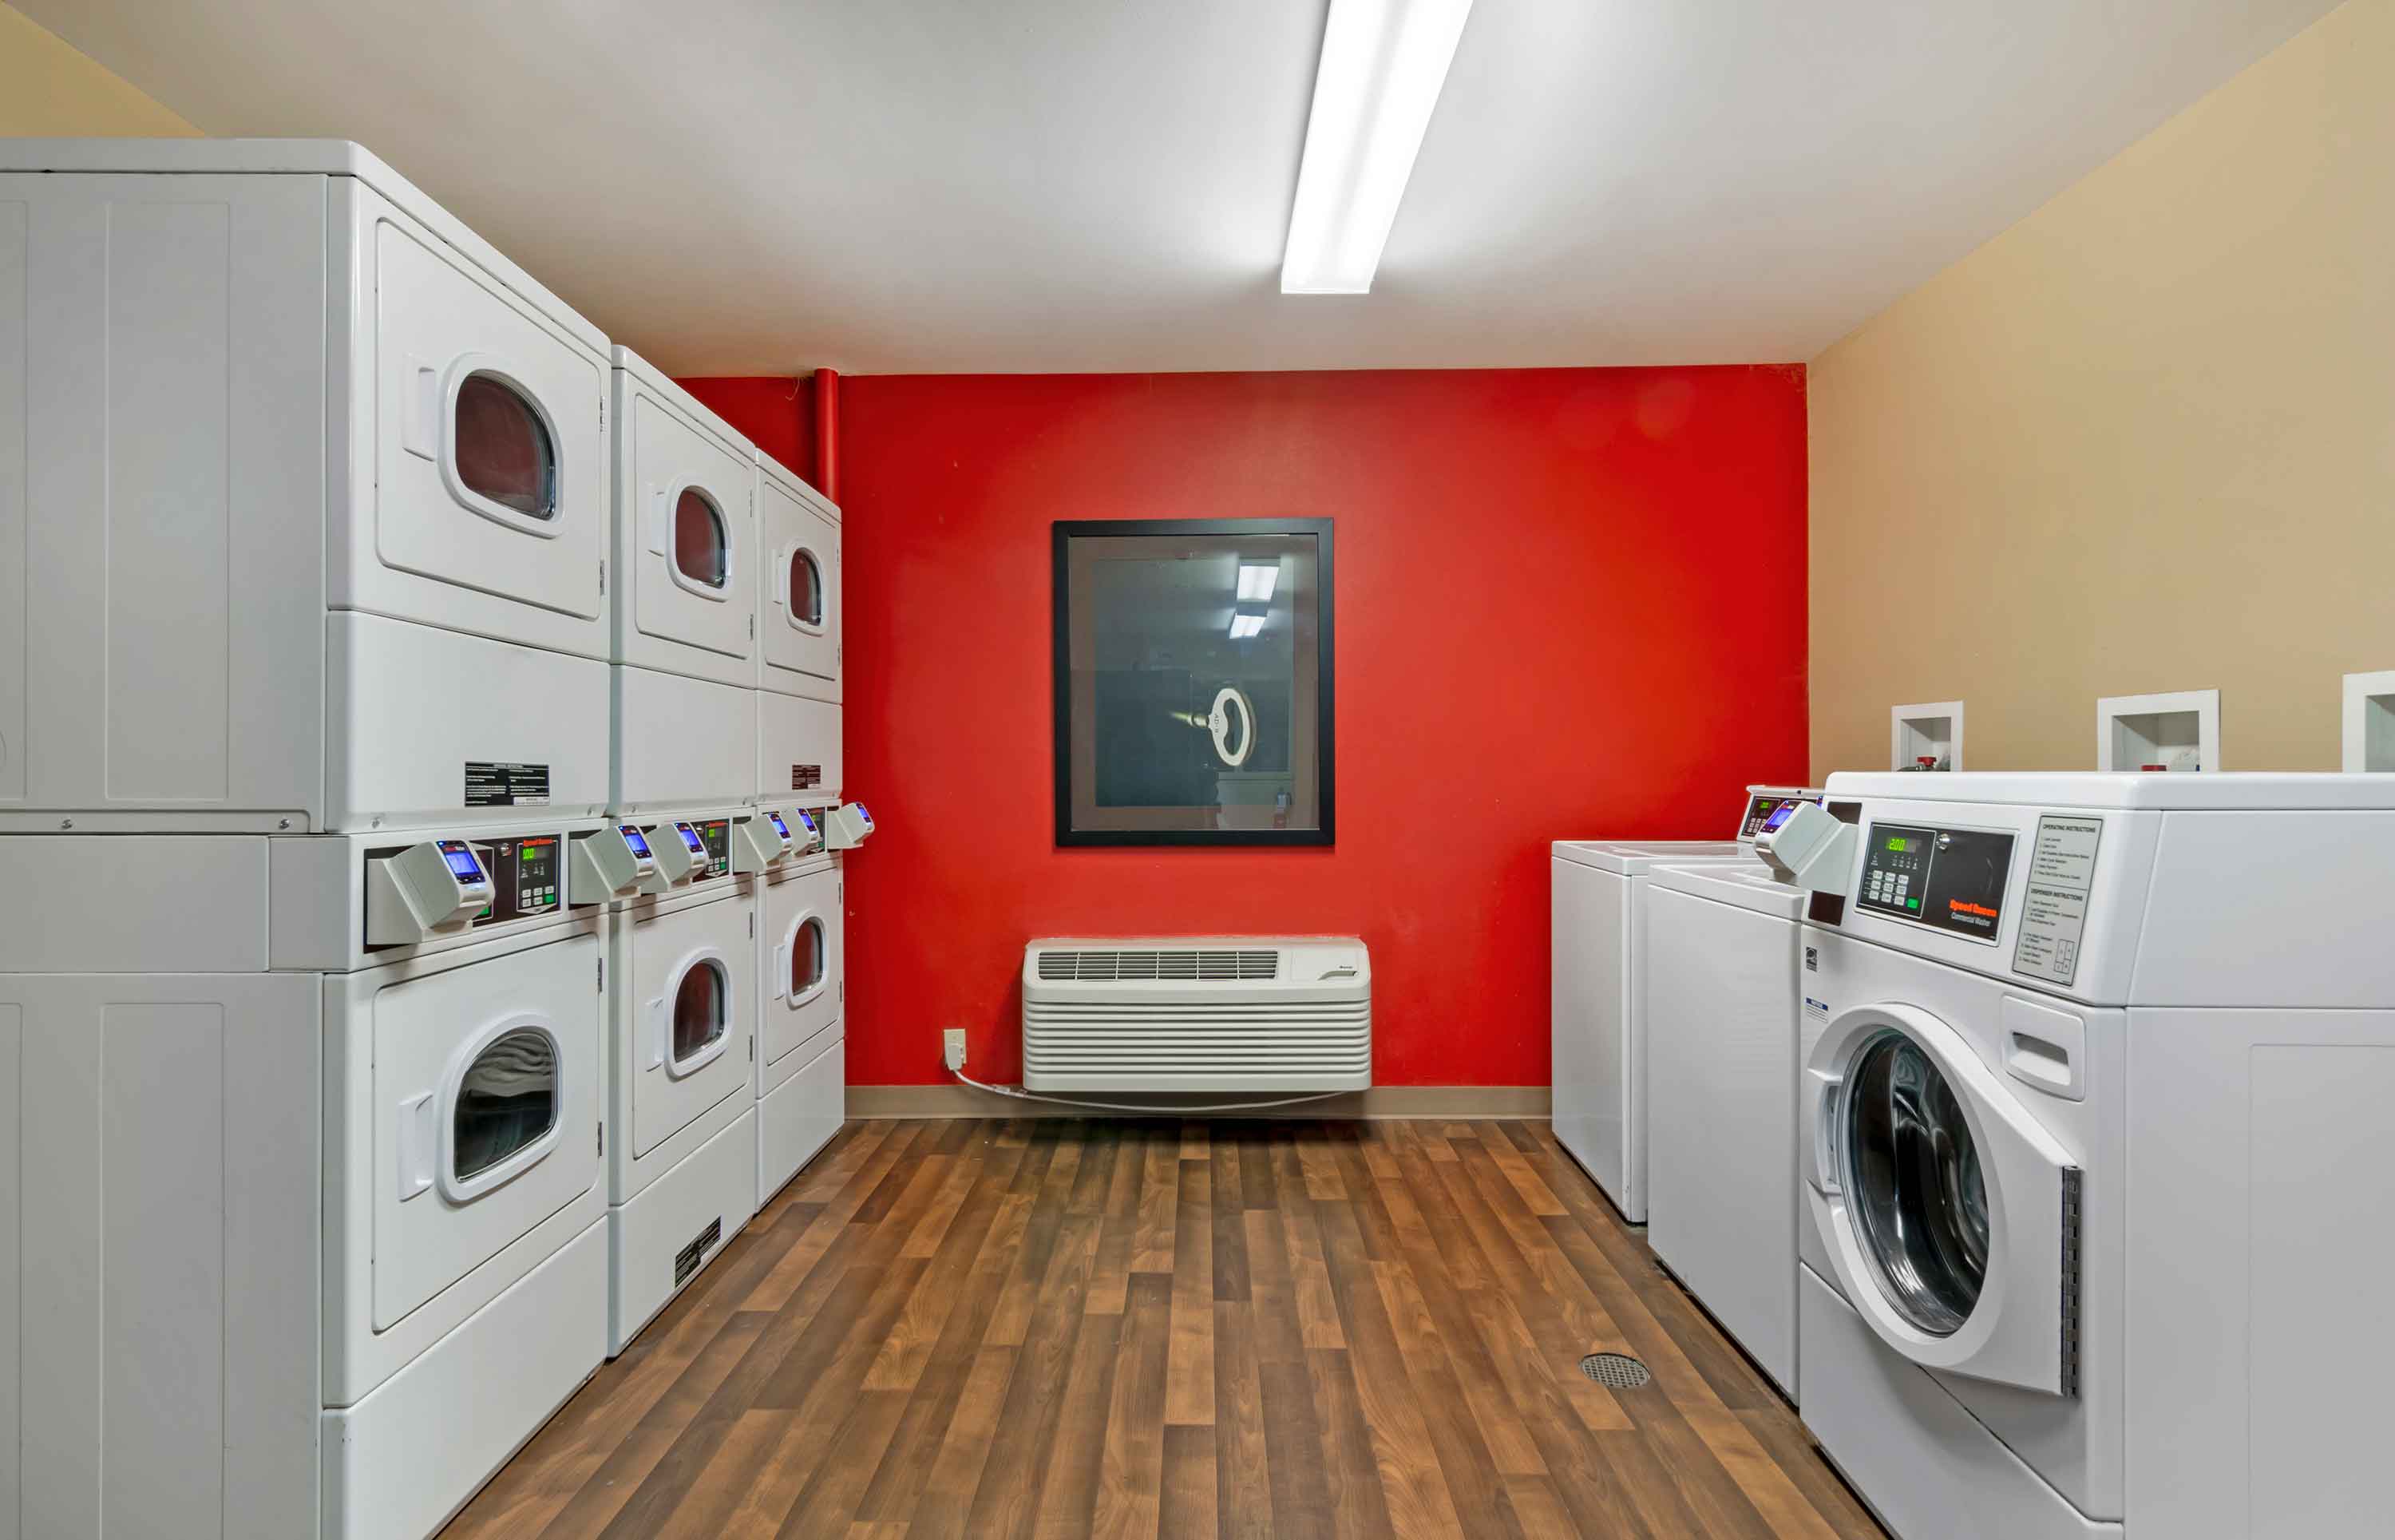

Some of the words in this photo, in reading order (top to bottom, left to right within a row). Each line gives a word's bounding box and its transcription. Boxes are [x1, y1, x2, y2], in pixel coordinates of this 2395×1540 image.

[2065, 825, 2096, 833] INSTRUCTIONS
[2053, 891, 2083, 901] INSTRUCTIONS
[1950, 899, 1973, 913] Speed
